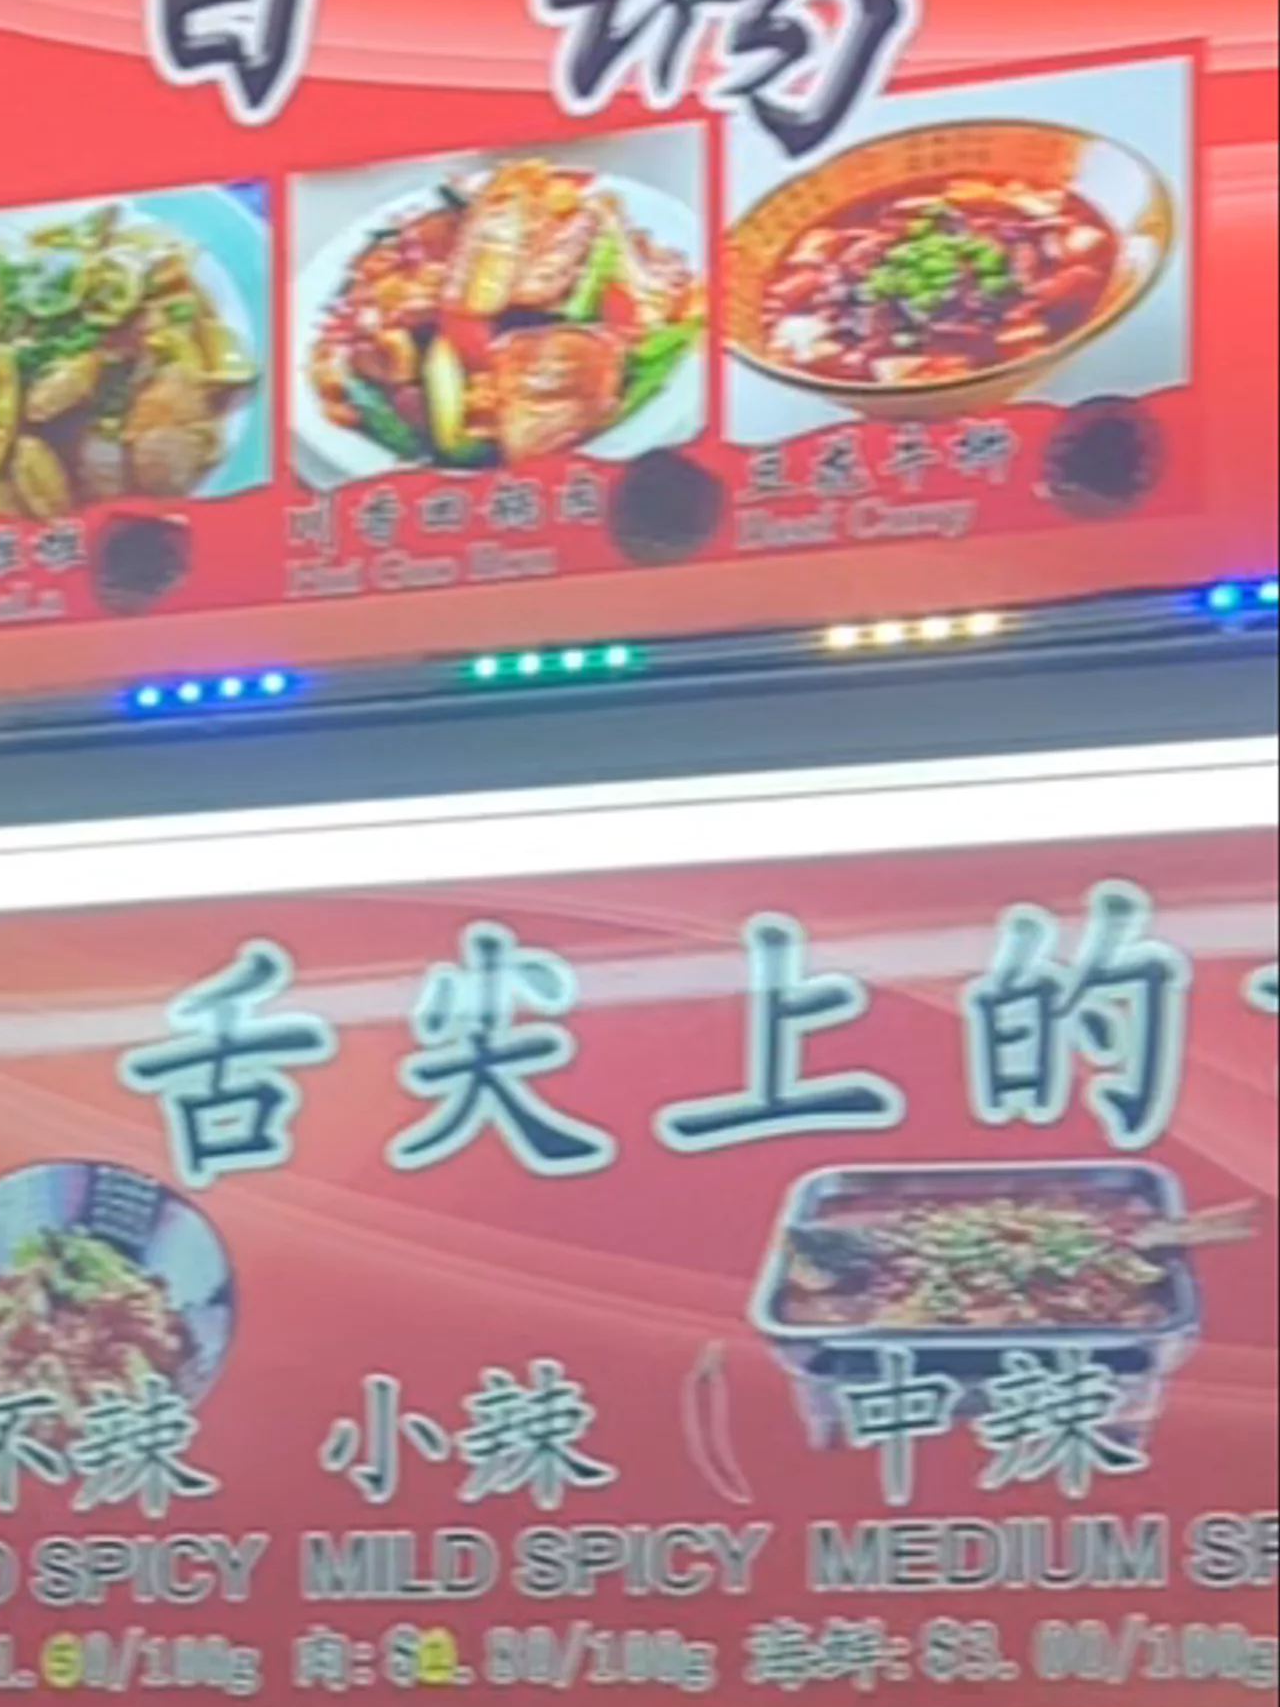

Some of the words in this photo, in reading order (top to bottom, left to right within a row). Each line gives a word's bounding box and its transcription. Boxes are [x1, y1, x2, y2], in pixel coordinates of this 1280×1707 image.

[116, 877, 1280, 1189] 舌尖上的
[320, 1357, 618, 1511] 小辣
[843, 1343, 1150, 1506] 中辣
[30, 1532, 272, 1607] SPICY
[298, 1527, 498, 1600] MILD
[511, 1521, 775, 1598] SPICY
[806, 1511, 1171, 1593] MEDIUM
